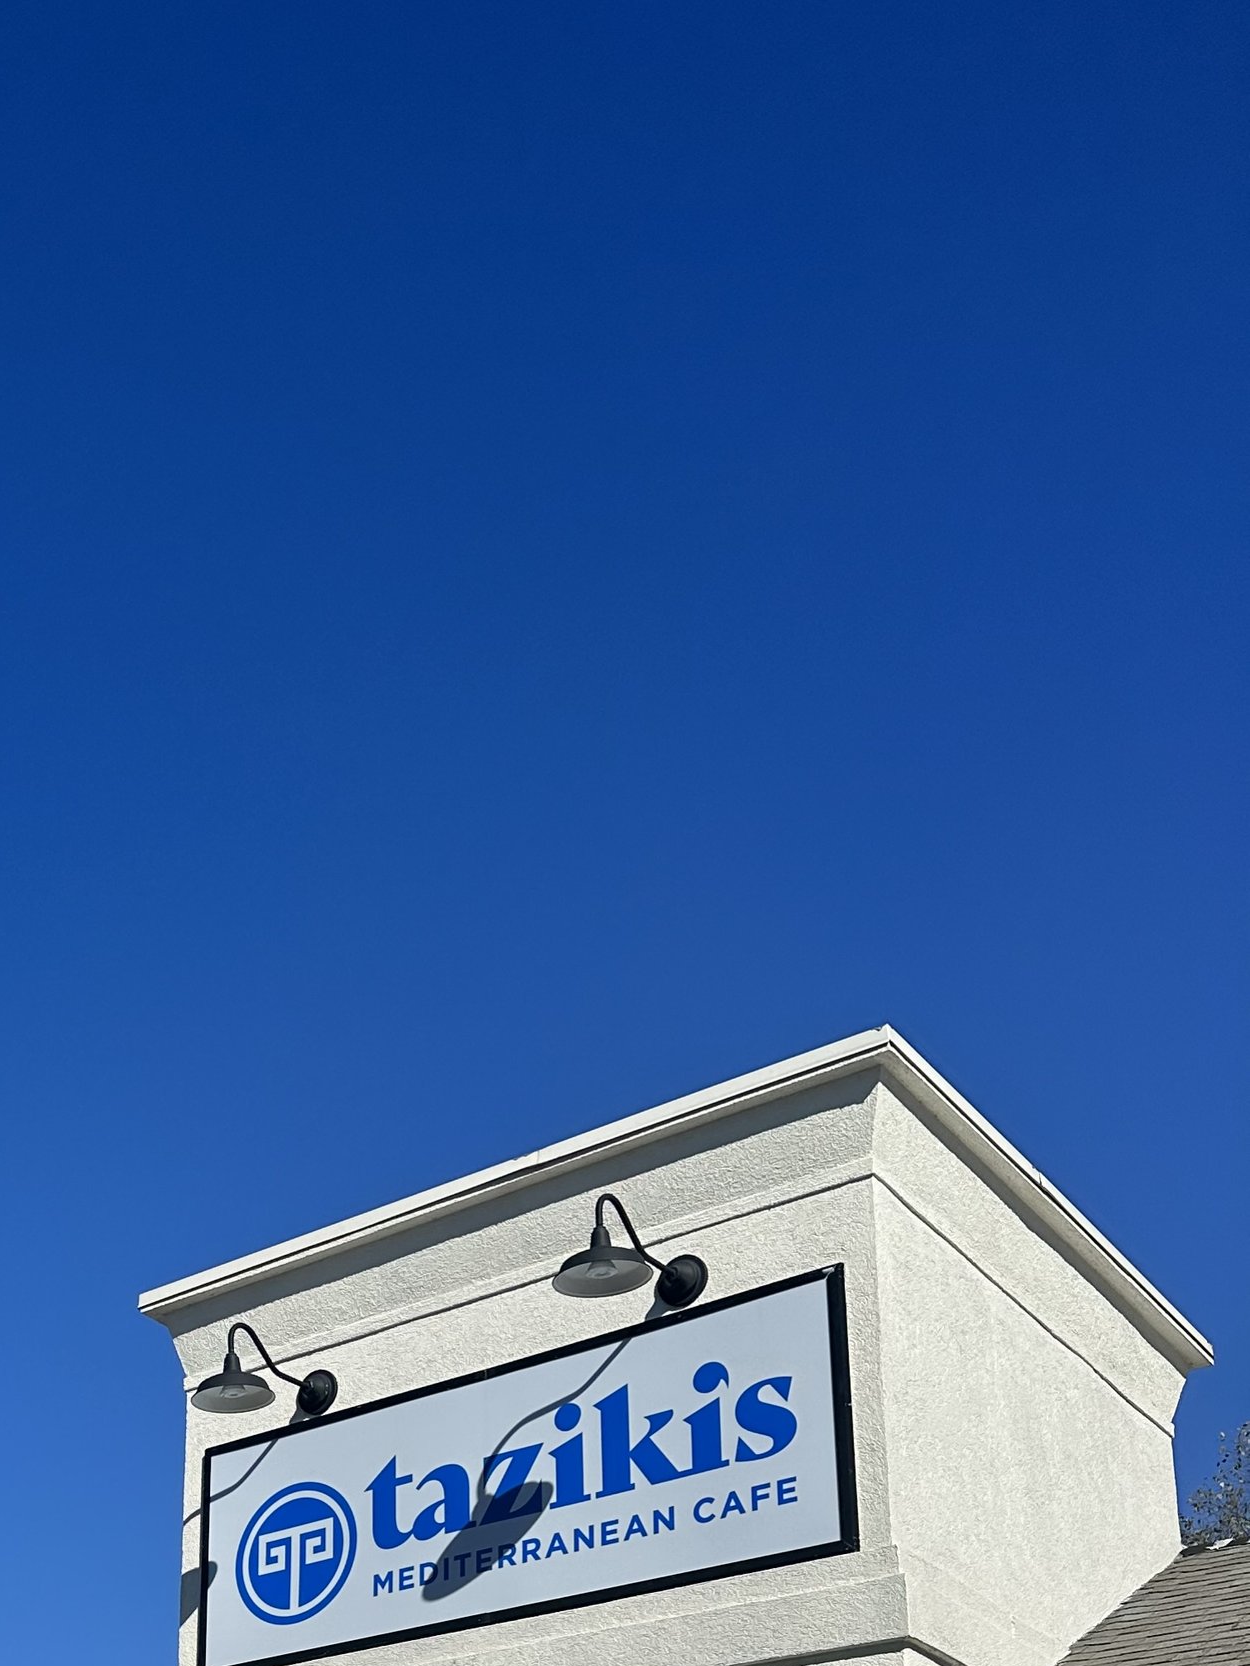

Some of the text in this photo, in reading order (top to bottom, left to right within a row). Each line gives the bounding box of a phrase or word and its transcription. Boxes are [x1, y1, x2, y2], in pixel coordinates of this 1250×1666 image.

[364, 1361, 797, 1550] tazikis
[373, 1476, 798, 1597] MEDITERRANEAN CAFE
